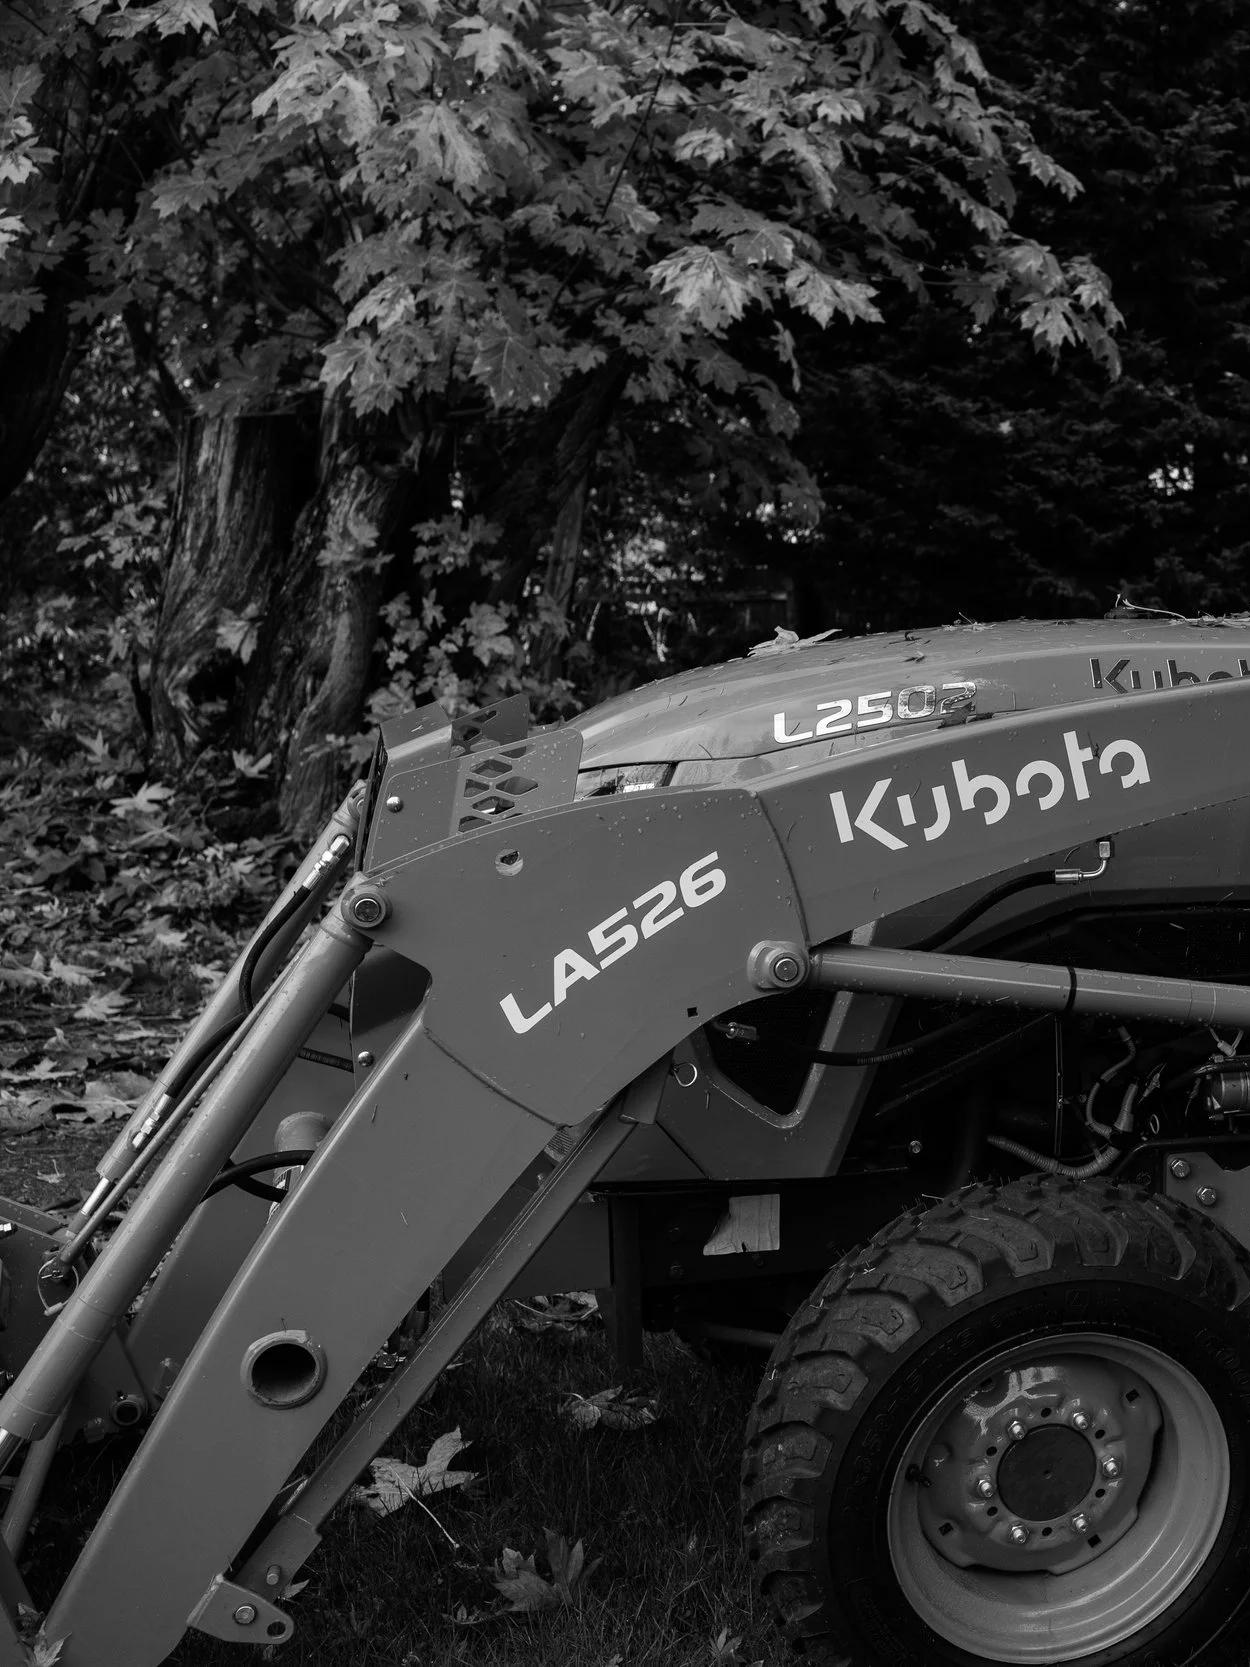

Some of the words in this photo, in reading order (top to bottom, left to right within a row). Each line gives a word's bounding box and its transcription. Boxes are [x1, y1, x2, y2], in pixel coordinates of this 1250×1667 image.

[774, 681, 977, 744] L2502
[829, 730, 1151, 851] Kubota
[500, 851, 727, 1034] LA526
